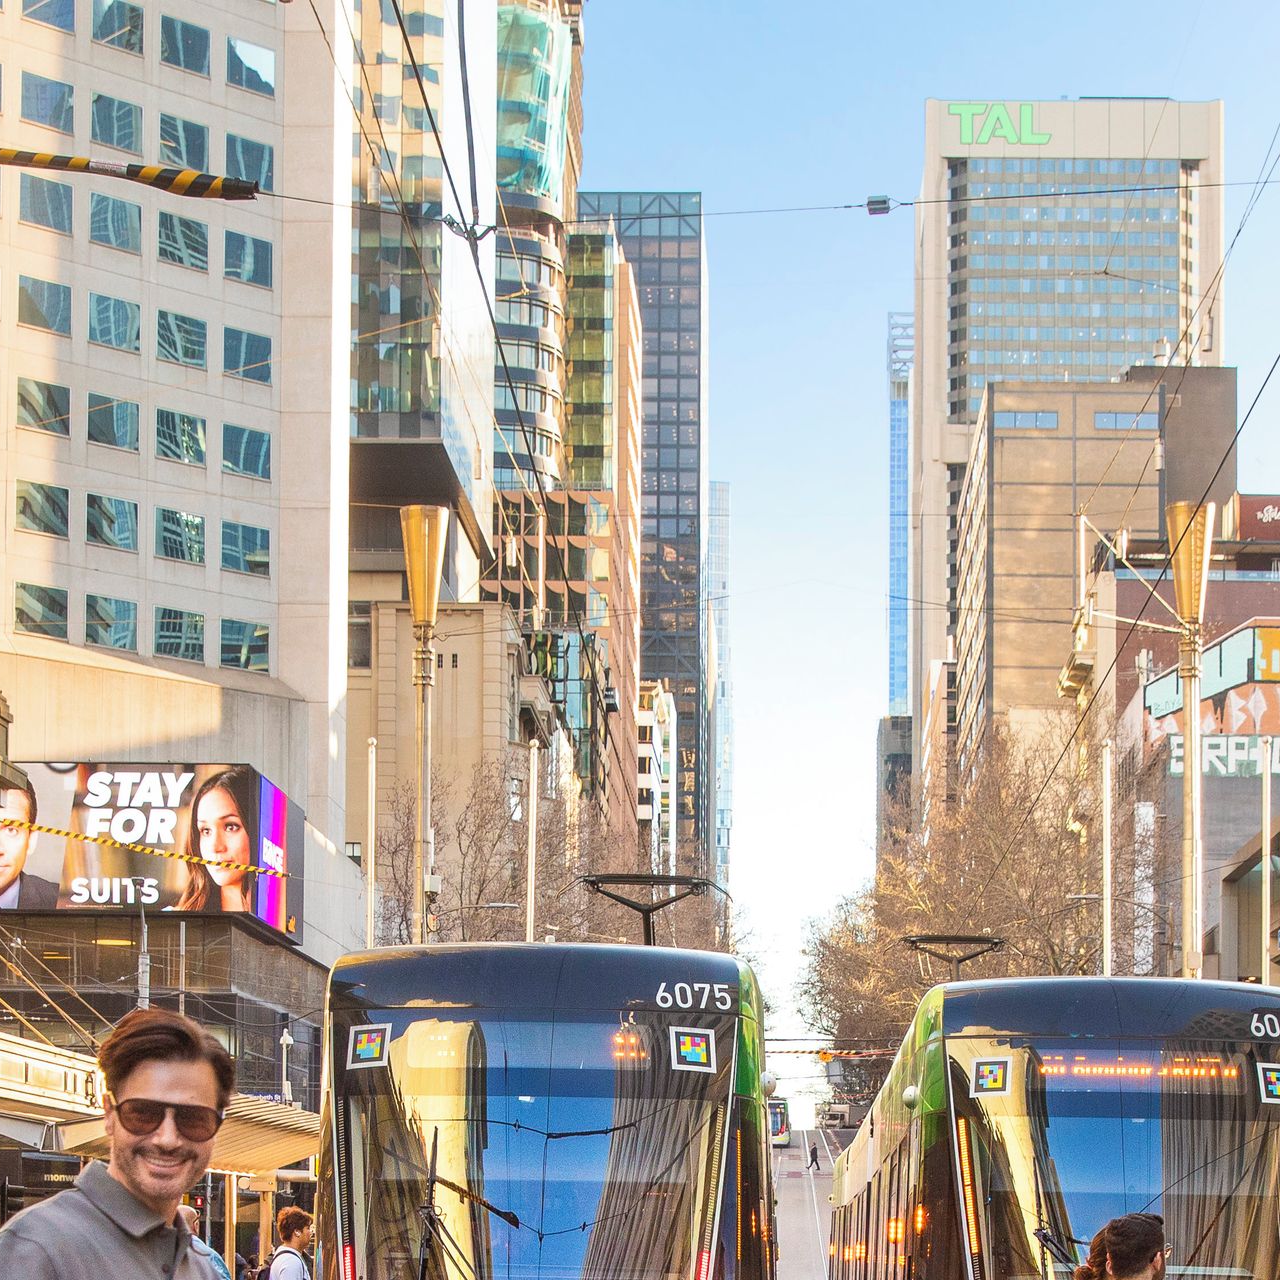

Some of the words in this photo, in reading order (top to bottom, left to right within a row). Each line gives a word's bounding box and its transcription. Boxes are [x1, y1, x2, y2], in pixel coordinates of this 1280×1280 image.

[947, 103, 1052, 145] TAL
[83, 771, 195, 808] STAY
[86, 808, 178, 845] FOR
[70, 877, 160, 904] SUITS
[656, 982, 732, 1010] 6075
